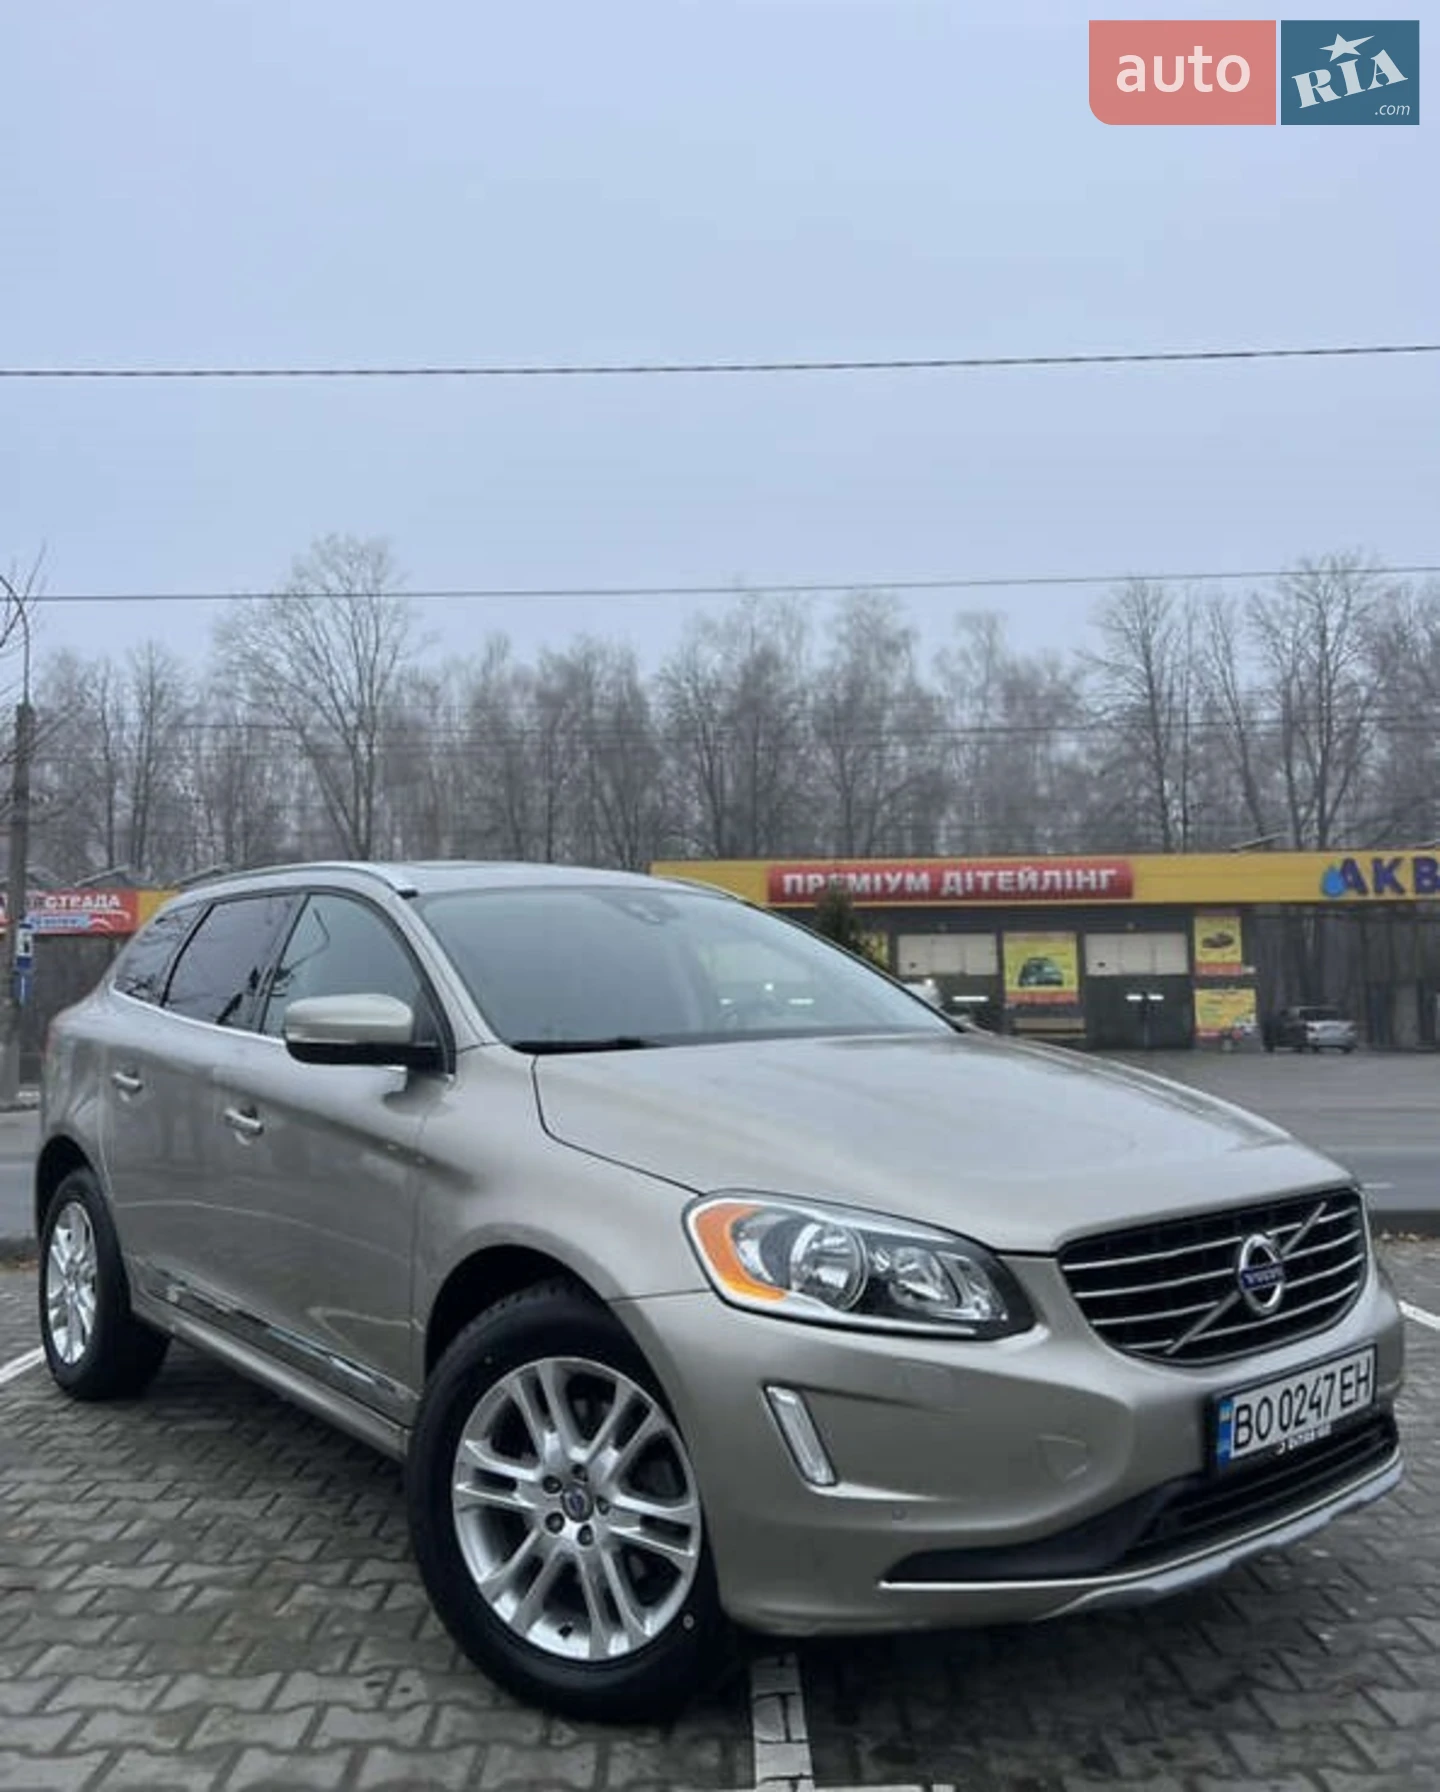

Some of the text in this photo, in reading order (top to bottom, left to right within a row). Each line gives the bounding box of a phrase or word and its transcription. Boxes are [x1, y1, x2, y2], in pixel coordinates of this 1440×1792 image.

[940, 866, 1117, 896] ДІТЕЙЛІНГ
[37, 893, 121, 910] СТРАДА
[1279, 1371, 1335, 1432] 0247
